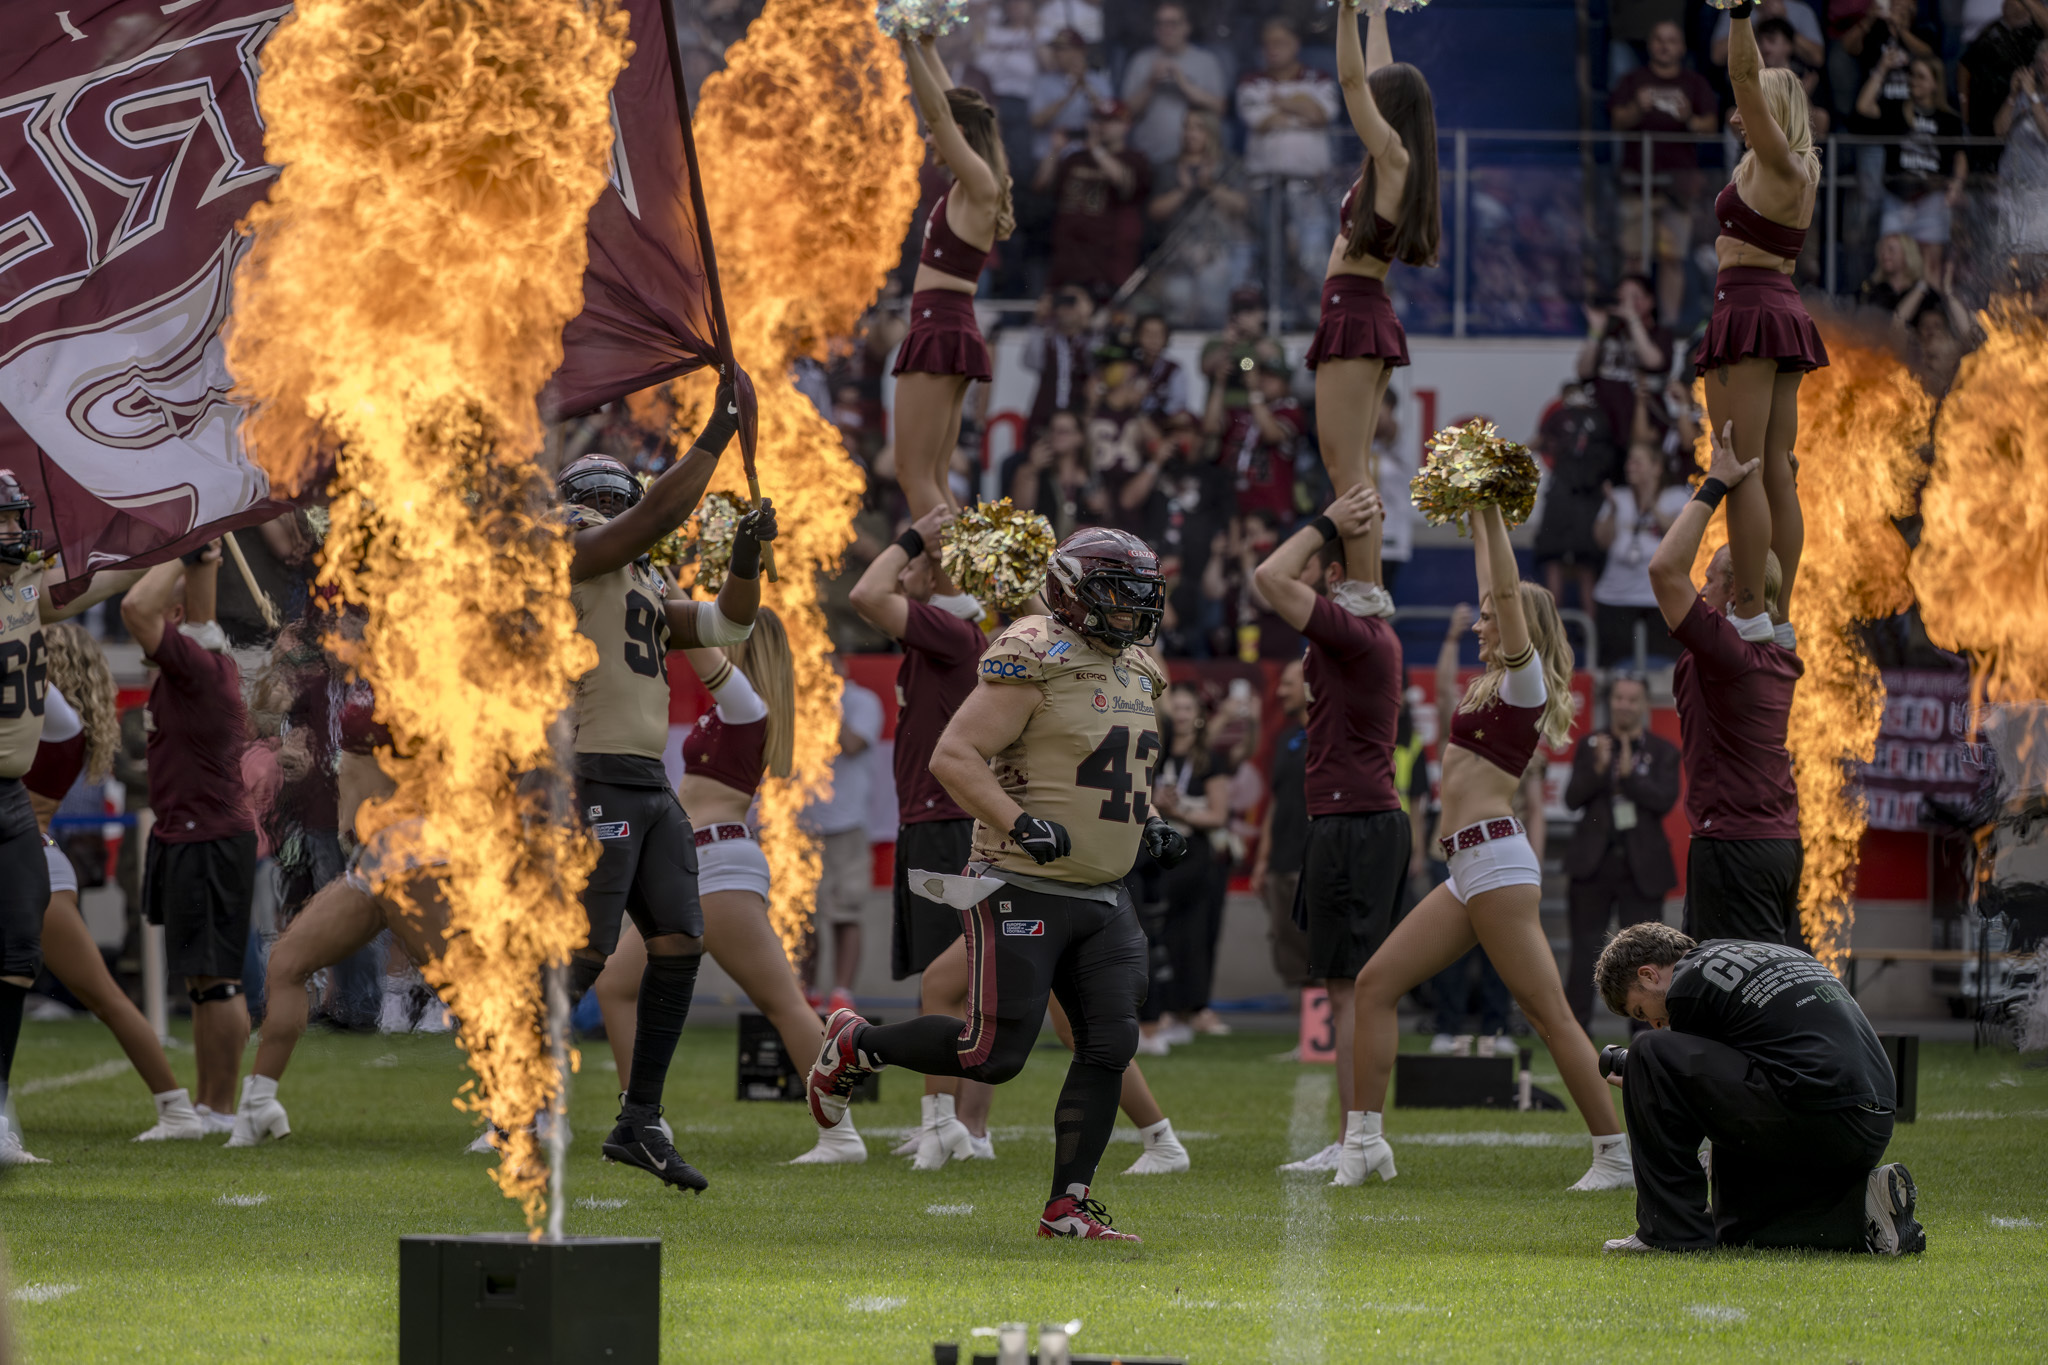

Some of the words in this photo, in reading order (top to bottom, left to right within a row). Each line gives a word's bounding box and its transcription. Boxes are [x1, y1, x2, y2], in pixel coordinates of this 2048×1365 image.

[982, 658, 1027, 679] pape
[1076, 725, 1160, 825] 43
[1741, 978, 1759, 996] JAYSON
[1757, 967, 1774, 980] TATUM
[1750, 991, 1765, 1004] LUKE
[1757, 993, 1773, 1009] JADEN
[1311, 997, 1336, 1053] 3
